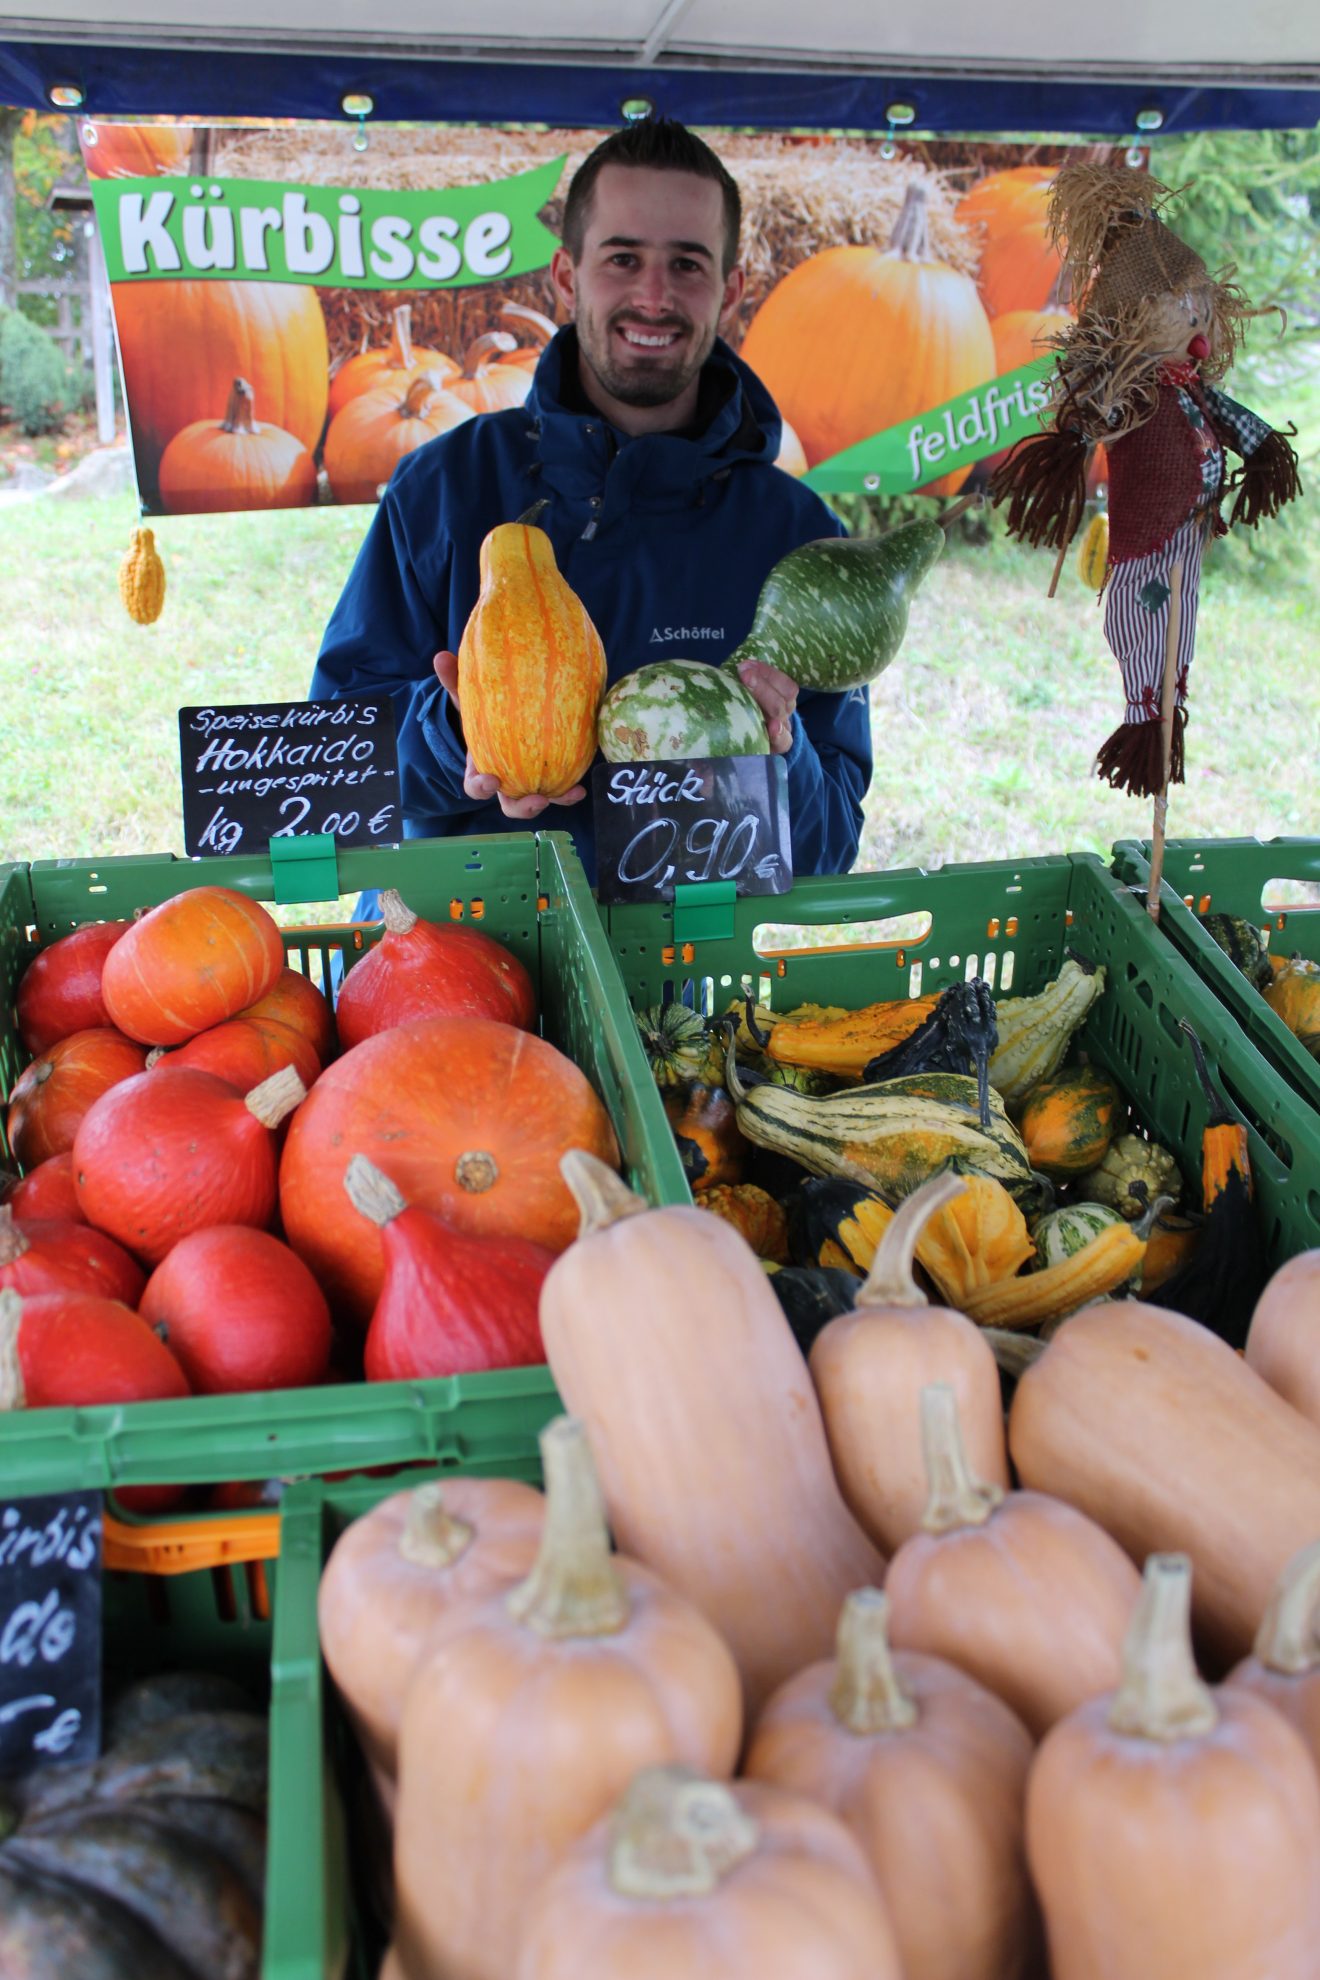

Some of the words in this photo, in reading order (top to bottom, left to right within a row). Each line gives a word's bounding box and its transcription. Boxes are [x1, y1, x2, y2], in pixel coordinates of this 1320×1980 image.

[118, 186, 513, 281] Kürbisse
[663, 626, 725, 640] Schöffel
[190, 704, 378, 737] Speisekürbis
[195, 734, 374, 773] Hokkaido
[607, 768, 705, 805] Stück
[367, 804, 395, 835] €
